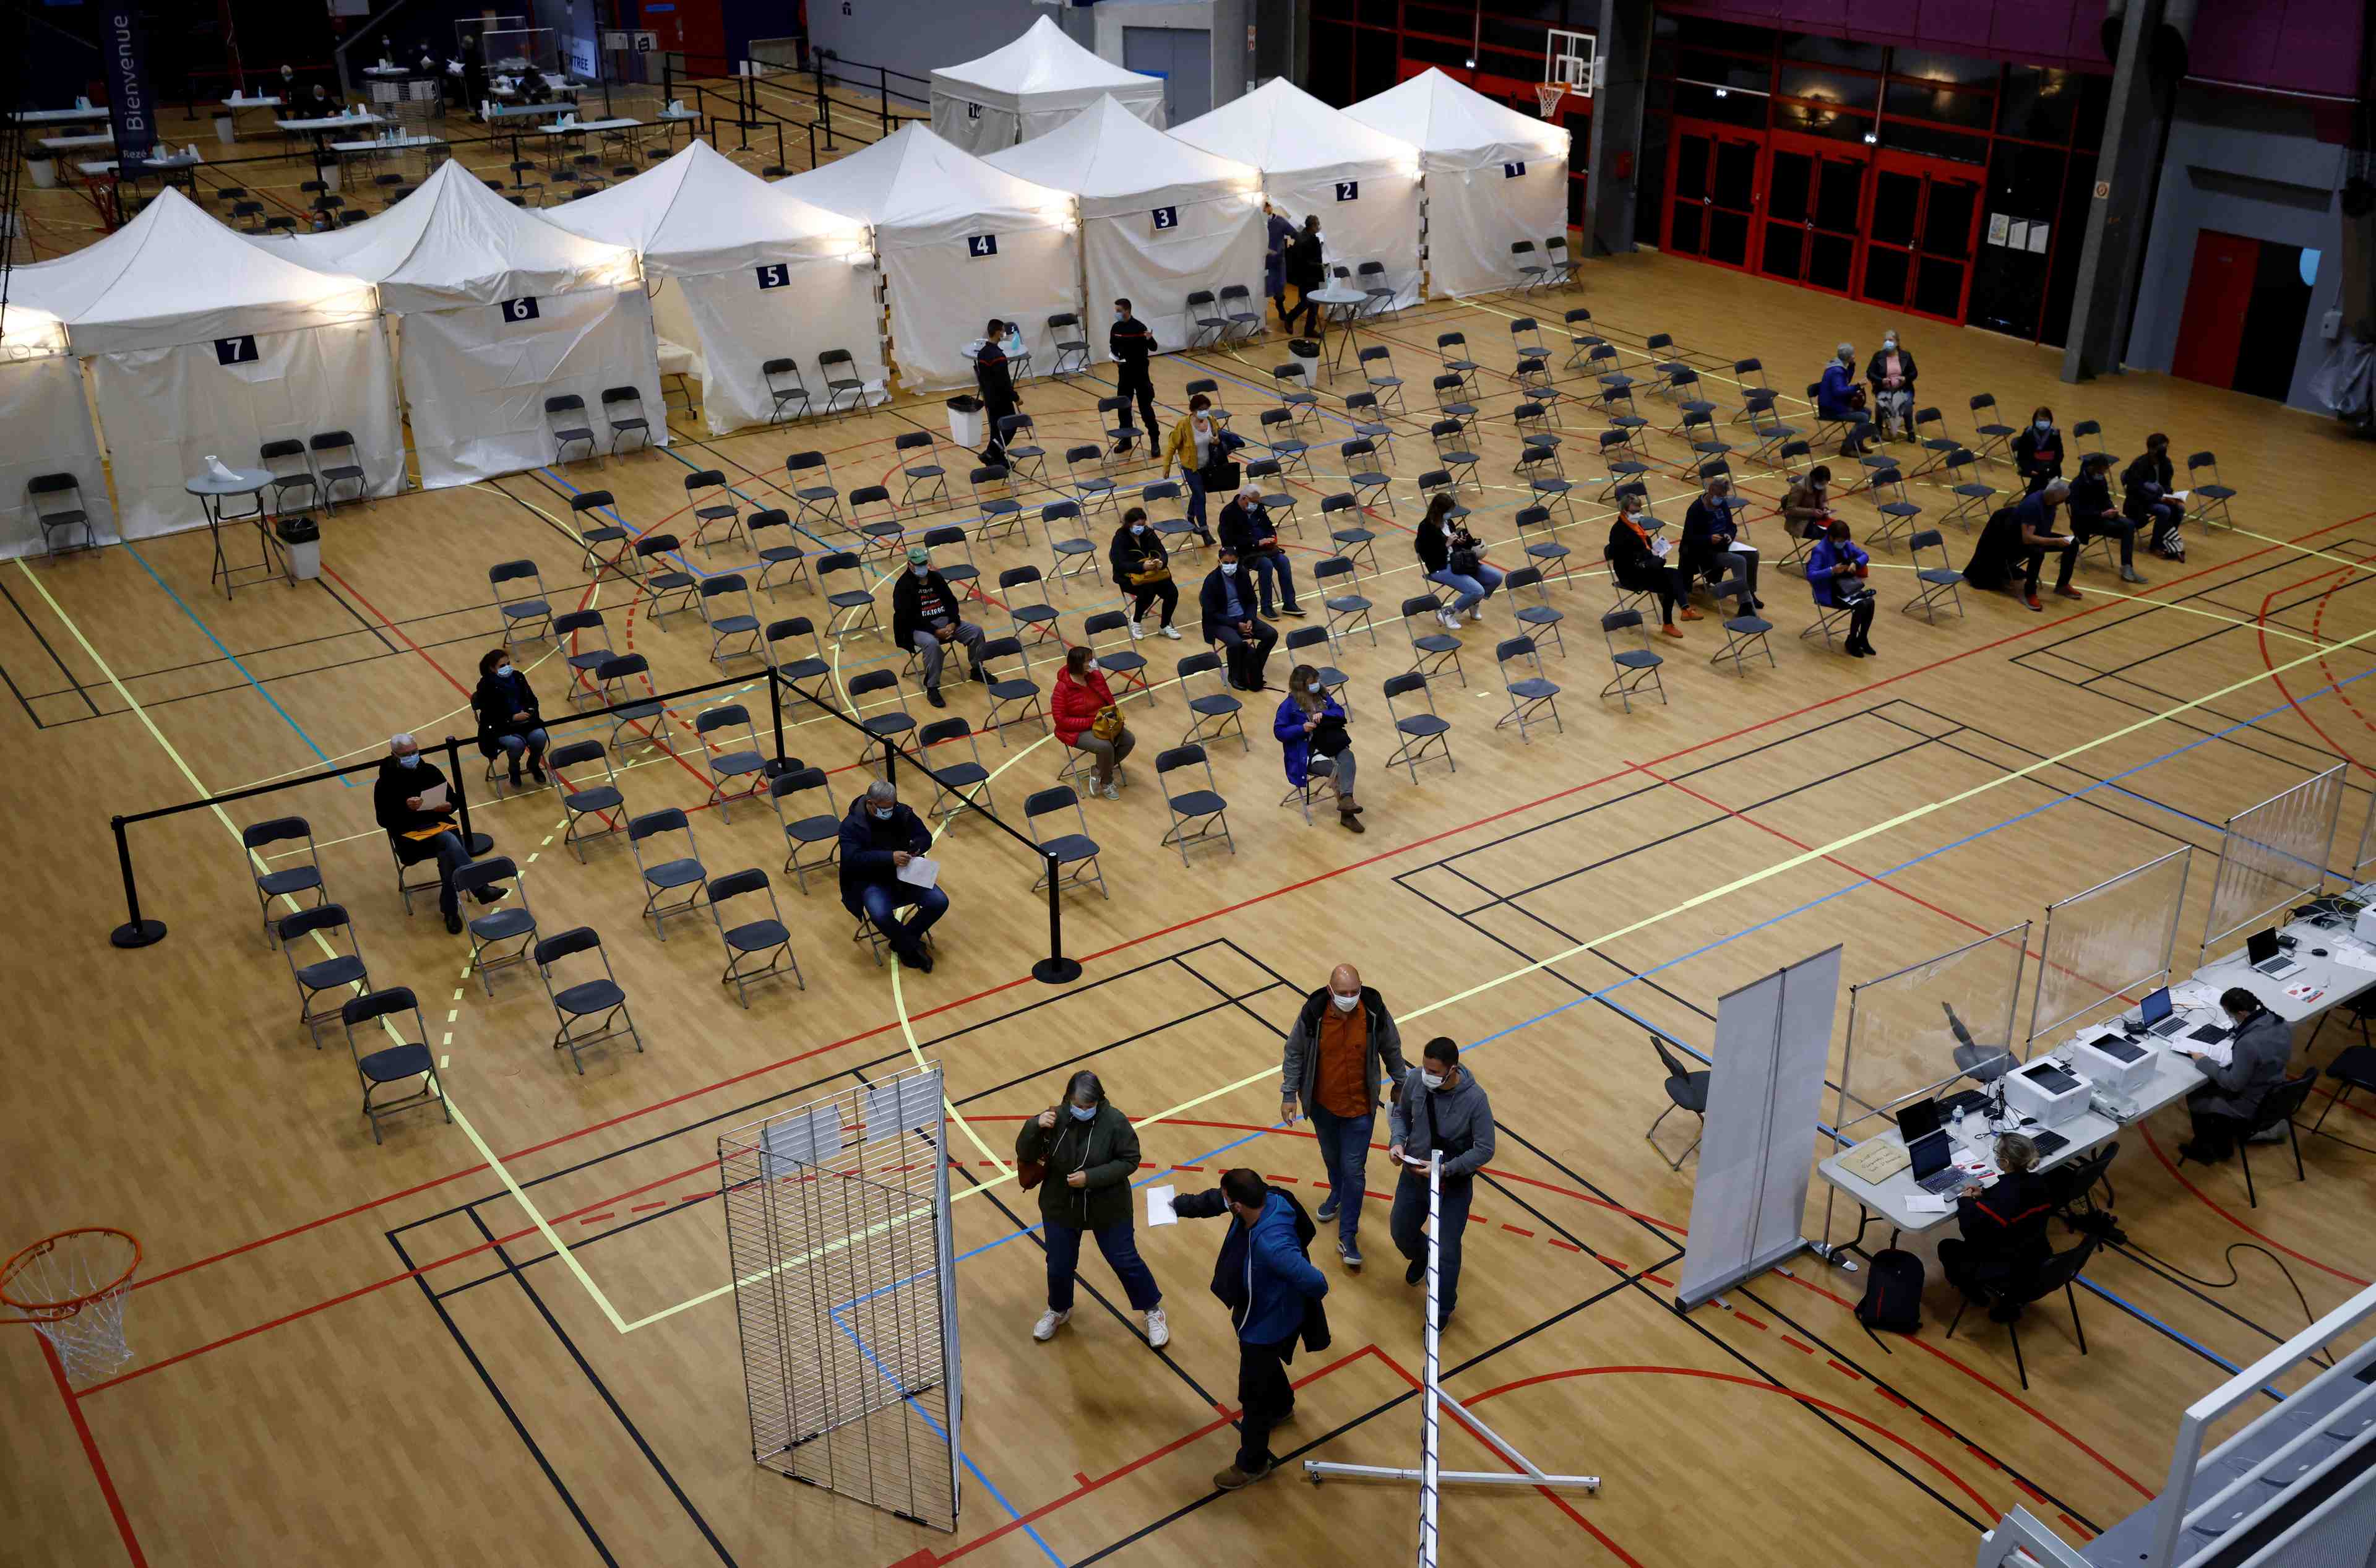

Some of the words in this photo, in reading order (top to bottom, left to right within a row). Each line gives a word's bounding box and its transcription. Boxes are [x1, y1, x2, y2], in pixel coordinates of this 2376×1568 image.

[566, 53, 588, 71] NTRÉE
[114, 15, 144, 131] Bienvenue
[1510, 163, 1518, 175] 1
[1342, 183, 1352, 199] 2
[1158, 209, 1169, 226] 3
[976, 236, 989, 254] 4
[767, 266, 780, 286] 5
[513, 298, 528, 319] 6
[226, 338, 243, 360] 7
